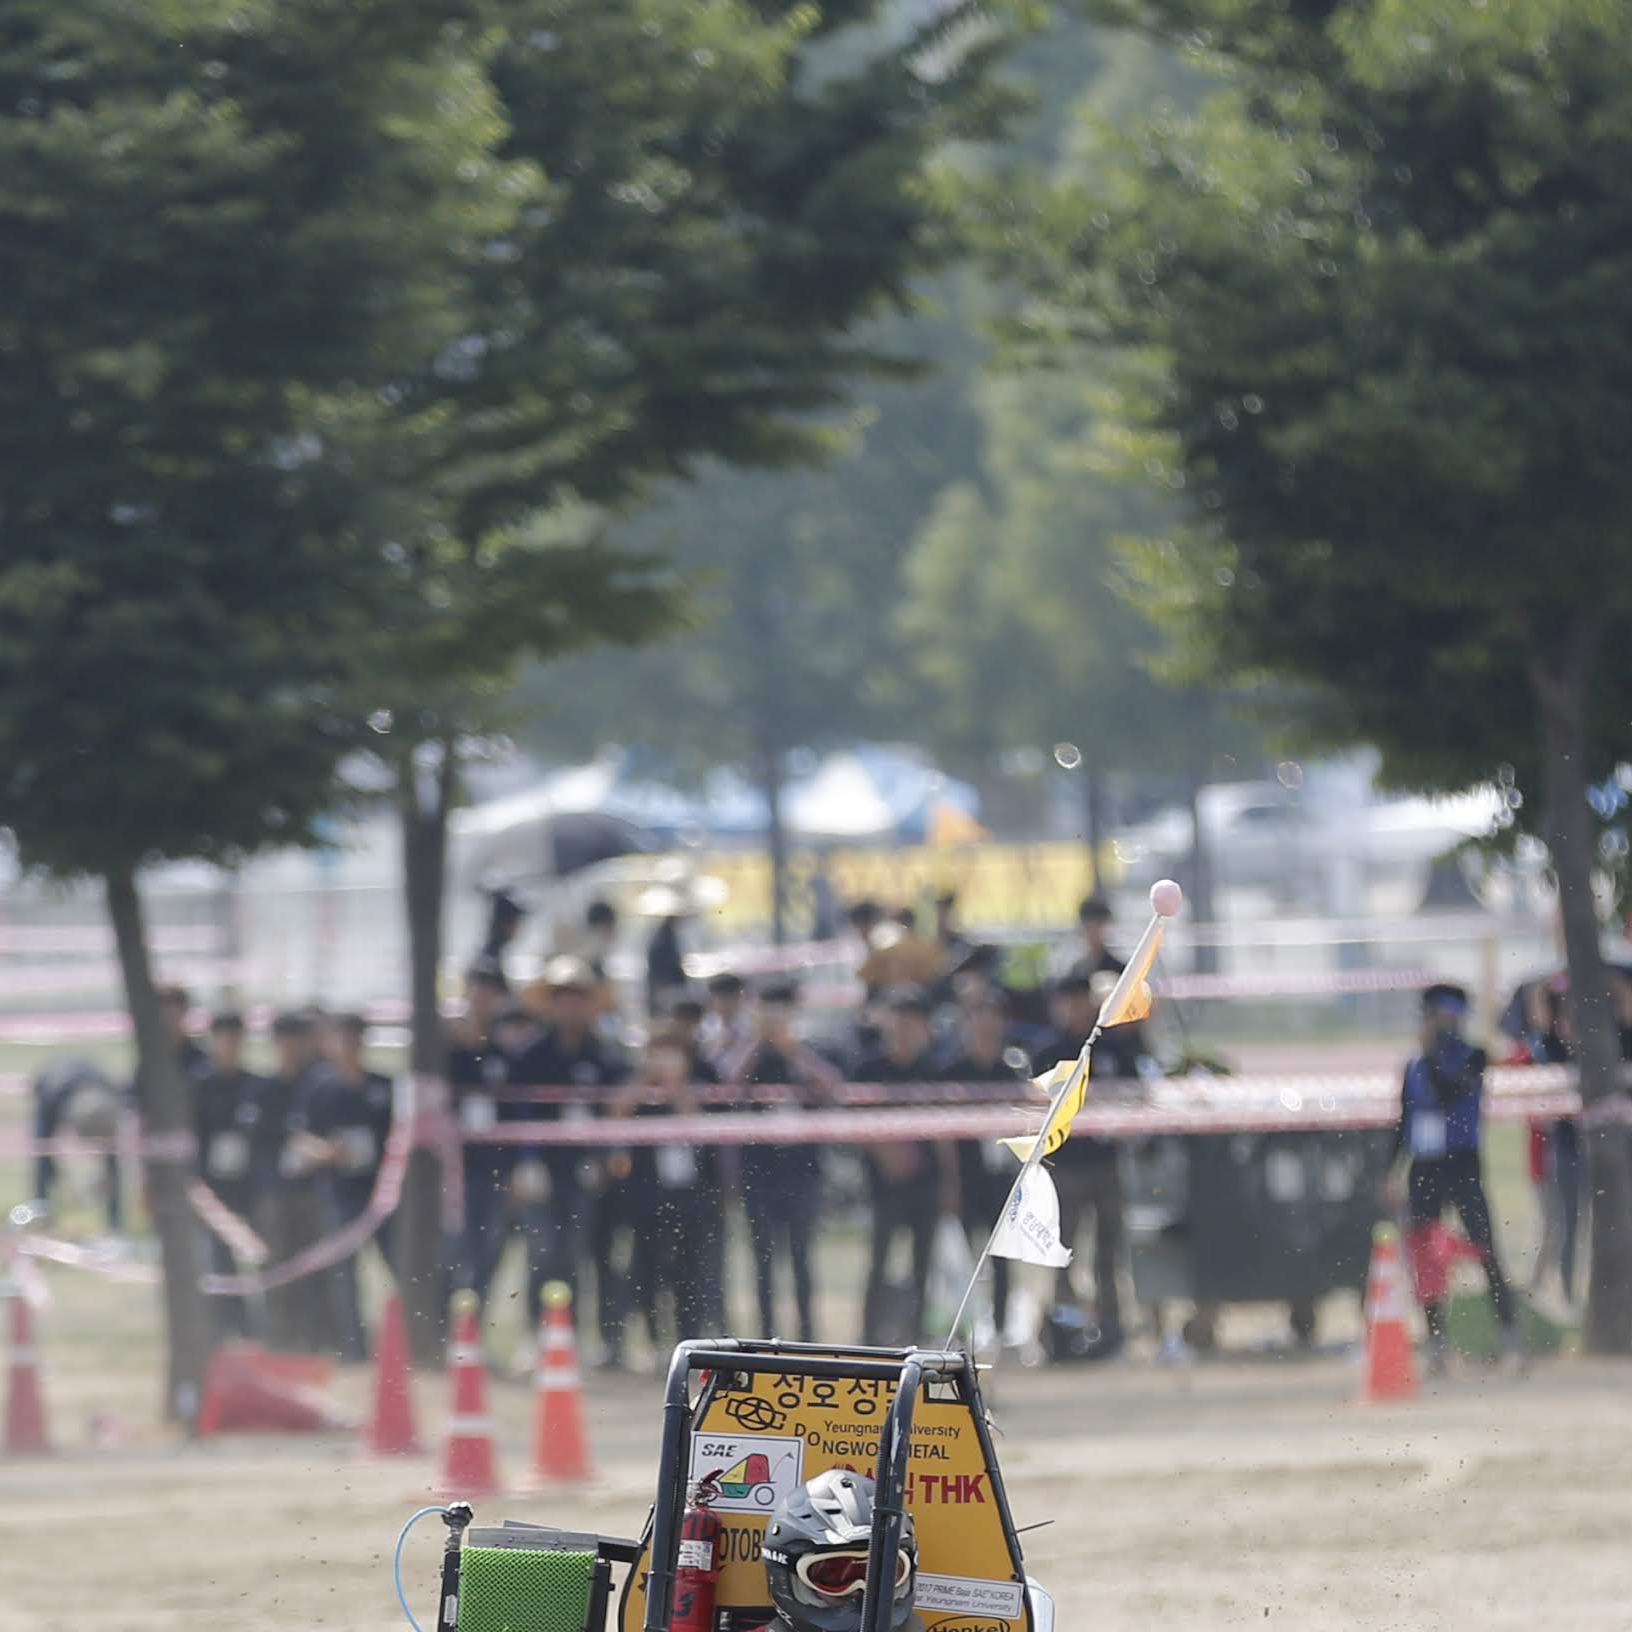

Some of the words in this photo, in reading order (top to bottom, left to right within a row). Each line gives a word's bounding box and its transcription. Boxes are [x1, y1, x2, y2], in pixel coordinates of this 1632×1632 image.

[794, 1423, 879, 1457] DONGWO
[824, 1421, 885, 1437] Yeungna
[910, 1423, 961, 1439] iversity
[702, 1443, 738, 1458] SAE
[919, 1474, 985, 1504] THK
[718, 1527, 765, 1562] OTOB
